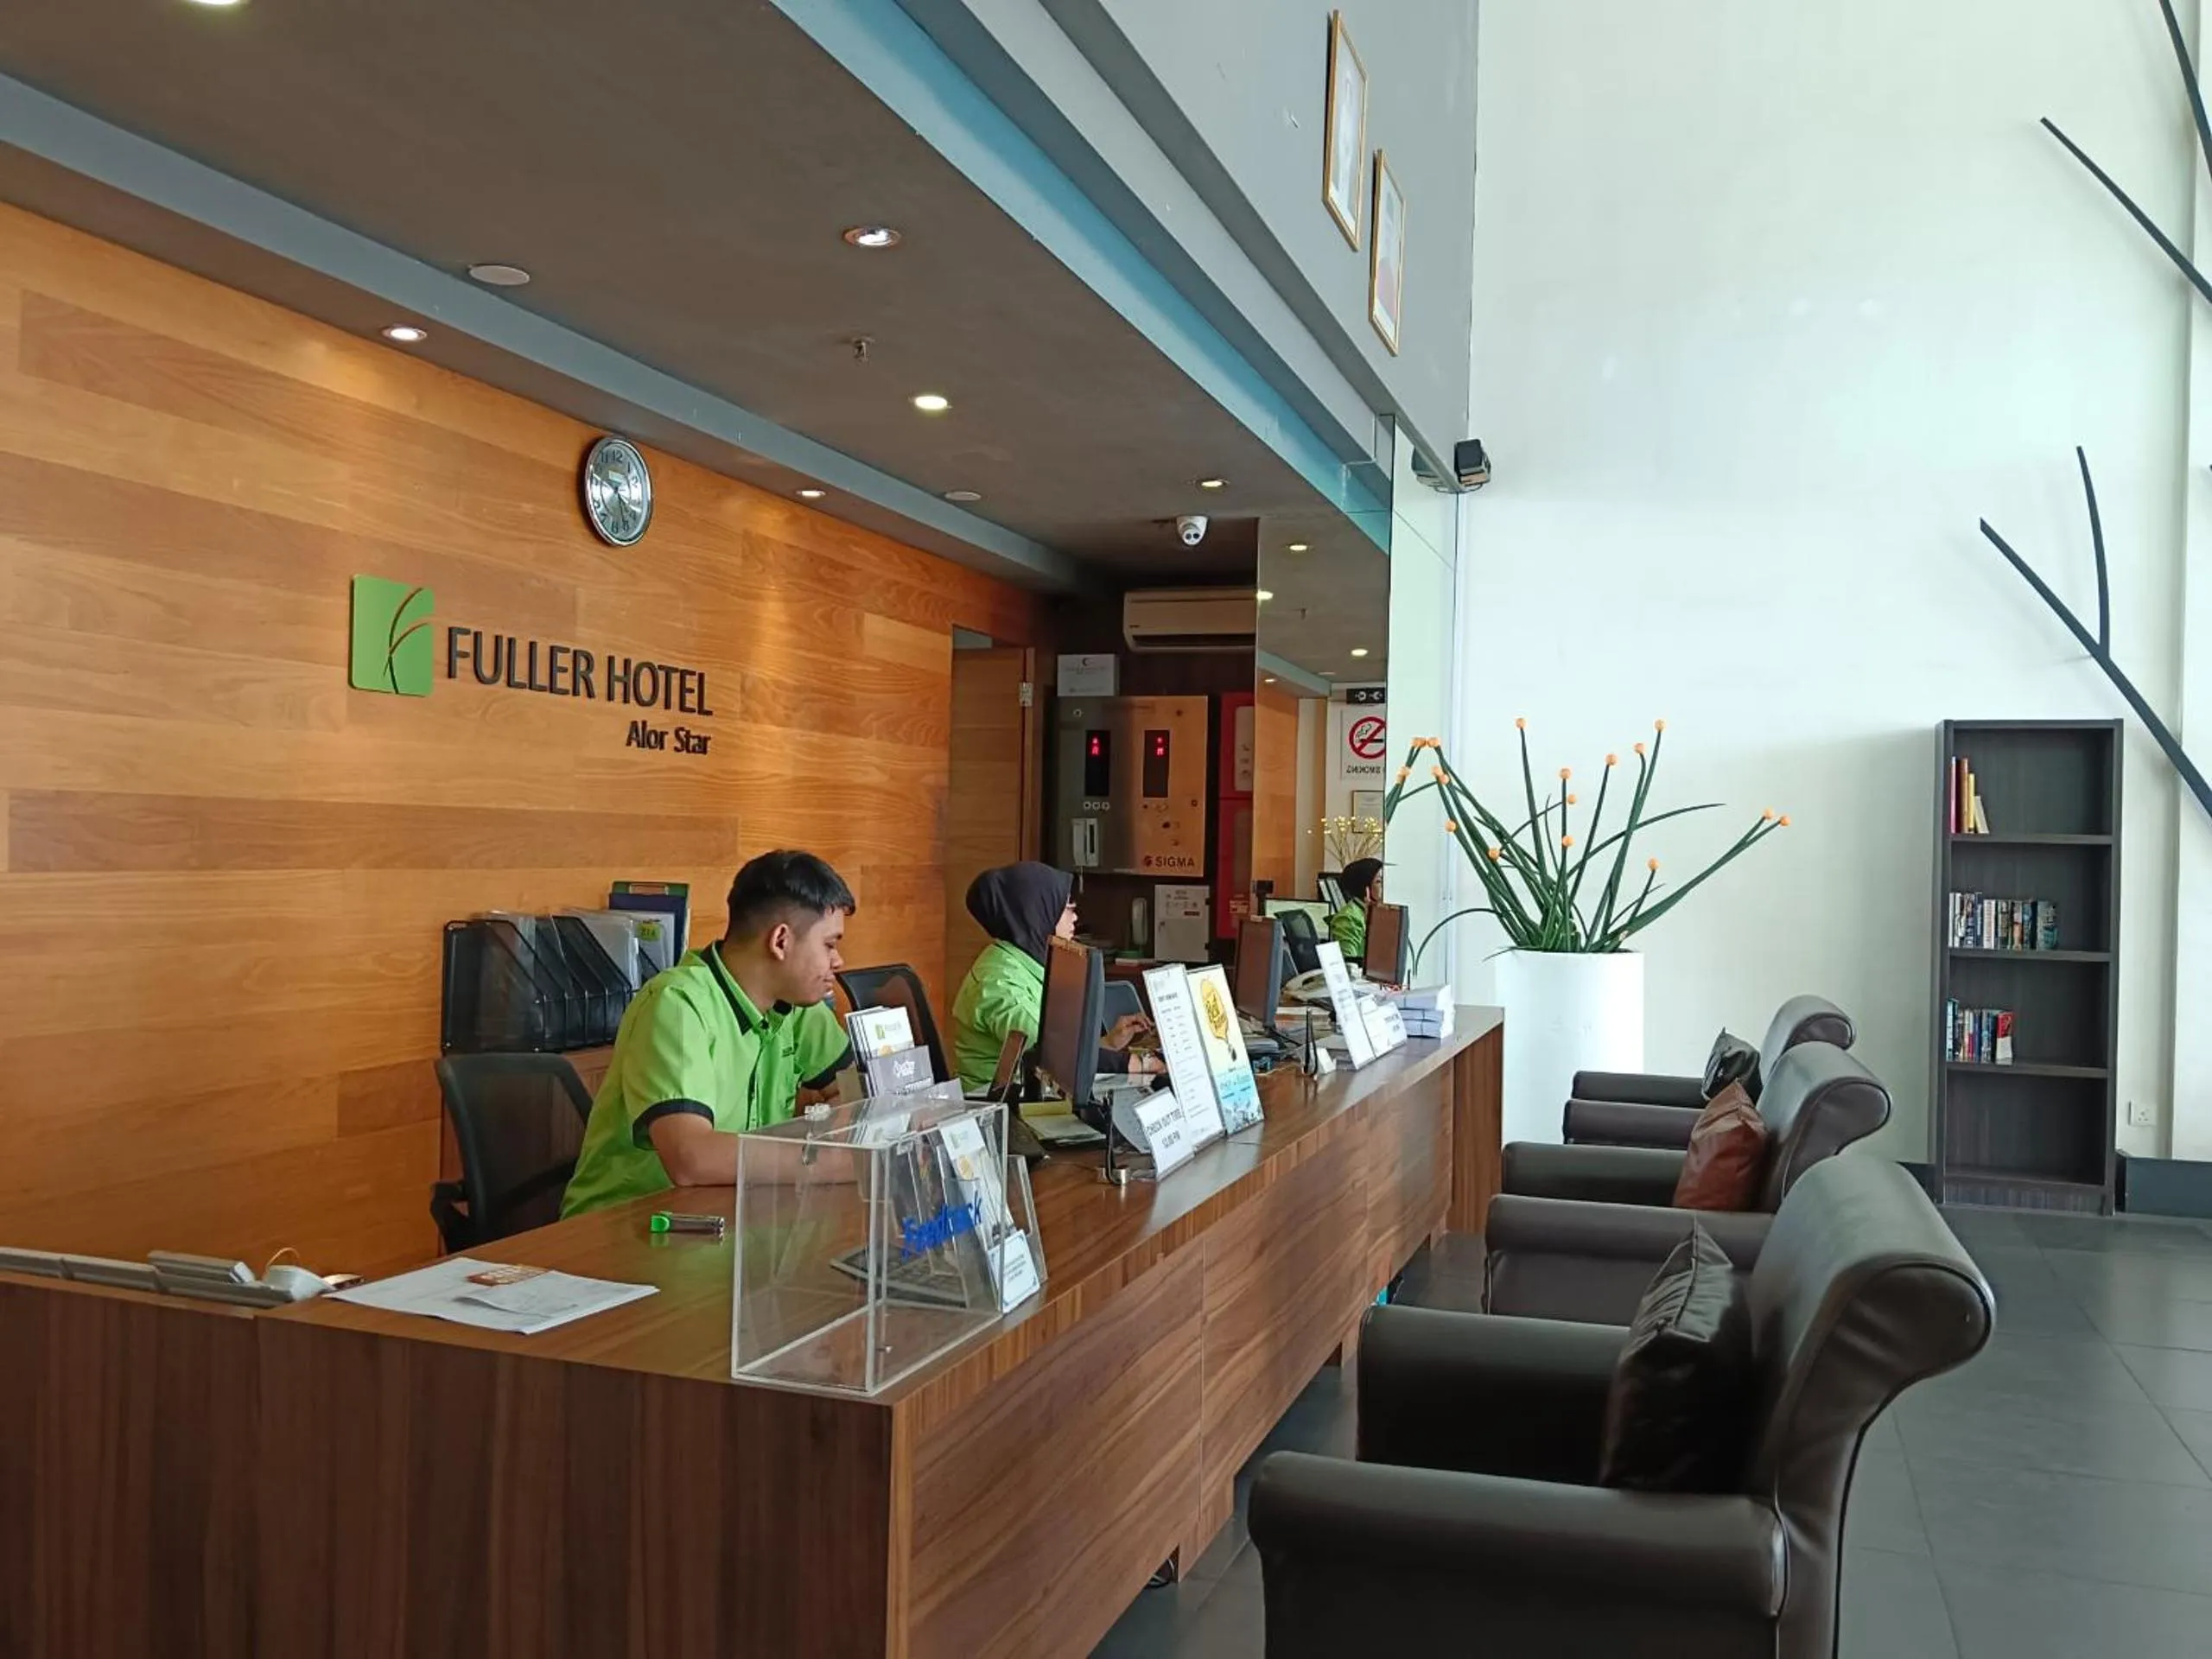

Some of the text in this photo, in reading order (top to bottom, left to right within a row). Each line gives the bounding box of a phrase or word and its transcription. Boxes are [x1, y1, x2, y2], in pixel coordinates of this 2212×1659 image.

[448, 626, 714, 716] FULLER HOTEL
[626, 720, 712, 755] Alor Star
[1154, 855, 1195, 868] SIGMA
